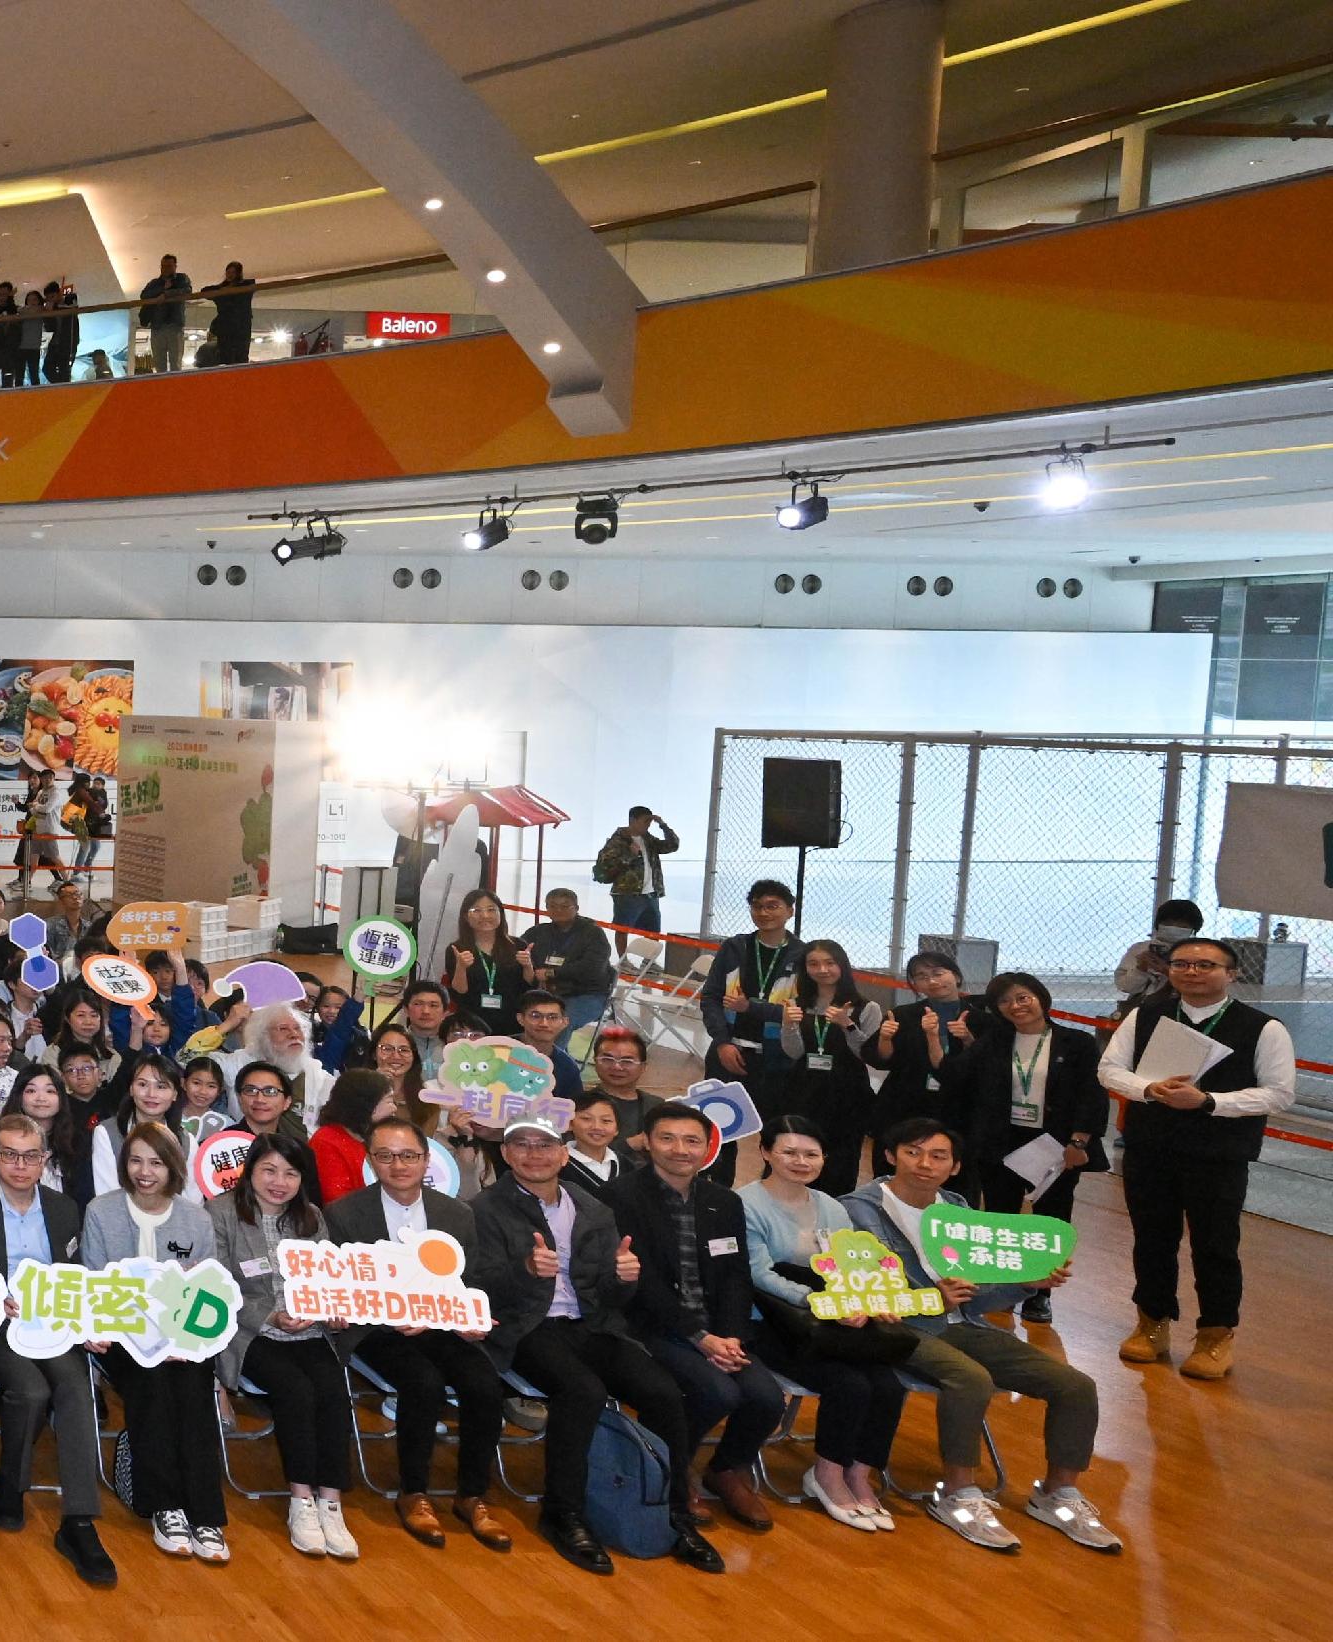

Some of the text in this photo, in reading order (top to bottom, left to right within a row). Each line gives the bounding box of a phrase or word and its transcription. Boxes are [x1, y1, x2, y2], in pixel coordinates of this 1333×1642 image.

[382, 317, 437, 334] Baleno
[329, 804, 344, 816] L1
[358, 948, 397, 969] 運動
[94, 965, 132, 979] 社交
[419, 1090, 574, 1129] 一起同行
[968, 1246, 1023, 1271] 承諾
[827, 1270, 906, 1293] 2025
[812, 1293, 941, 1316] 精神健康月
